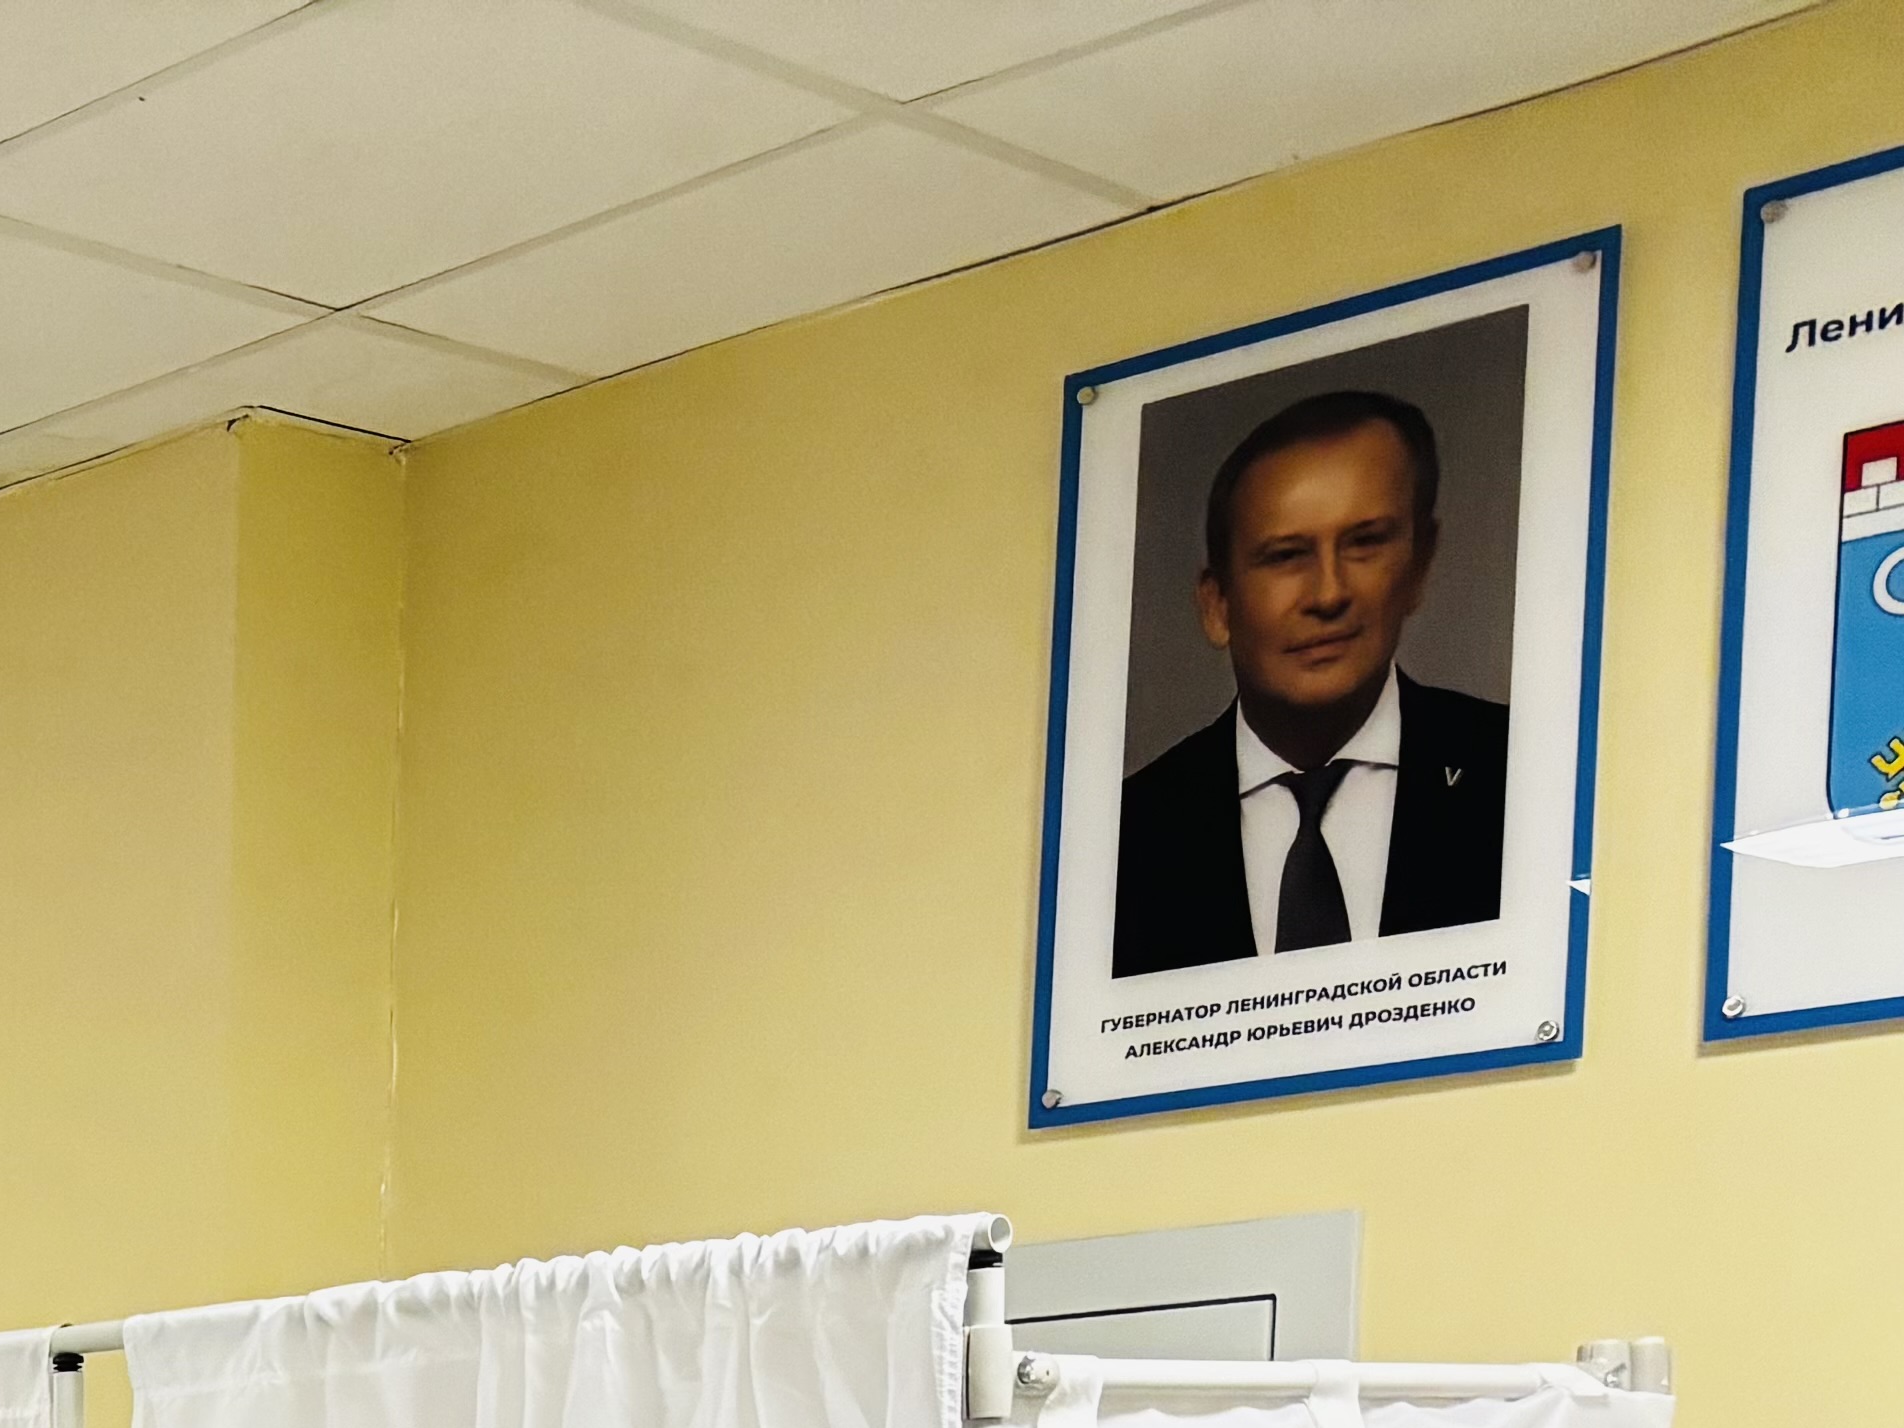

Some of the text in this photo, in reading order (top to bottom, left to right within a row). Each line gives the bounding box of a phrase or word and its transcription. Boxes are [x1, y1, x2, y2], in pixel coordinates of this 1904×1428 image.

[1100, 960, 1508, 1033] ГУБЕРНАТОР ЛЕНИНГРАДСКОЙ ОБЛАСТИ
[1124, 997, 1476, 1060] АЛЕКСАНДР ЮРЬЕВИЧ ДРОЗДЕНКО
